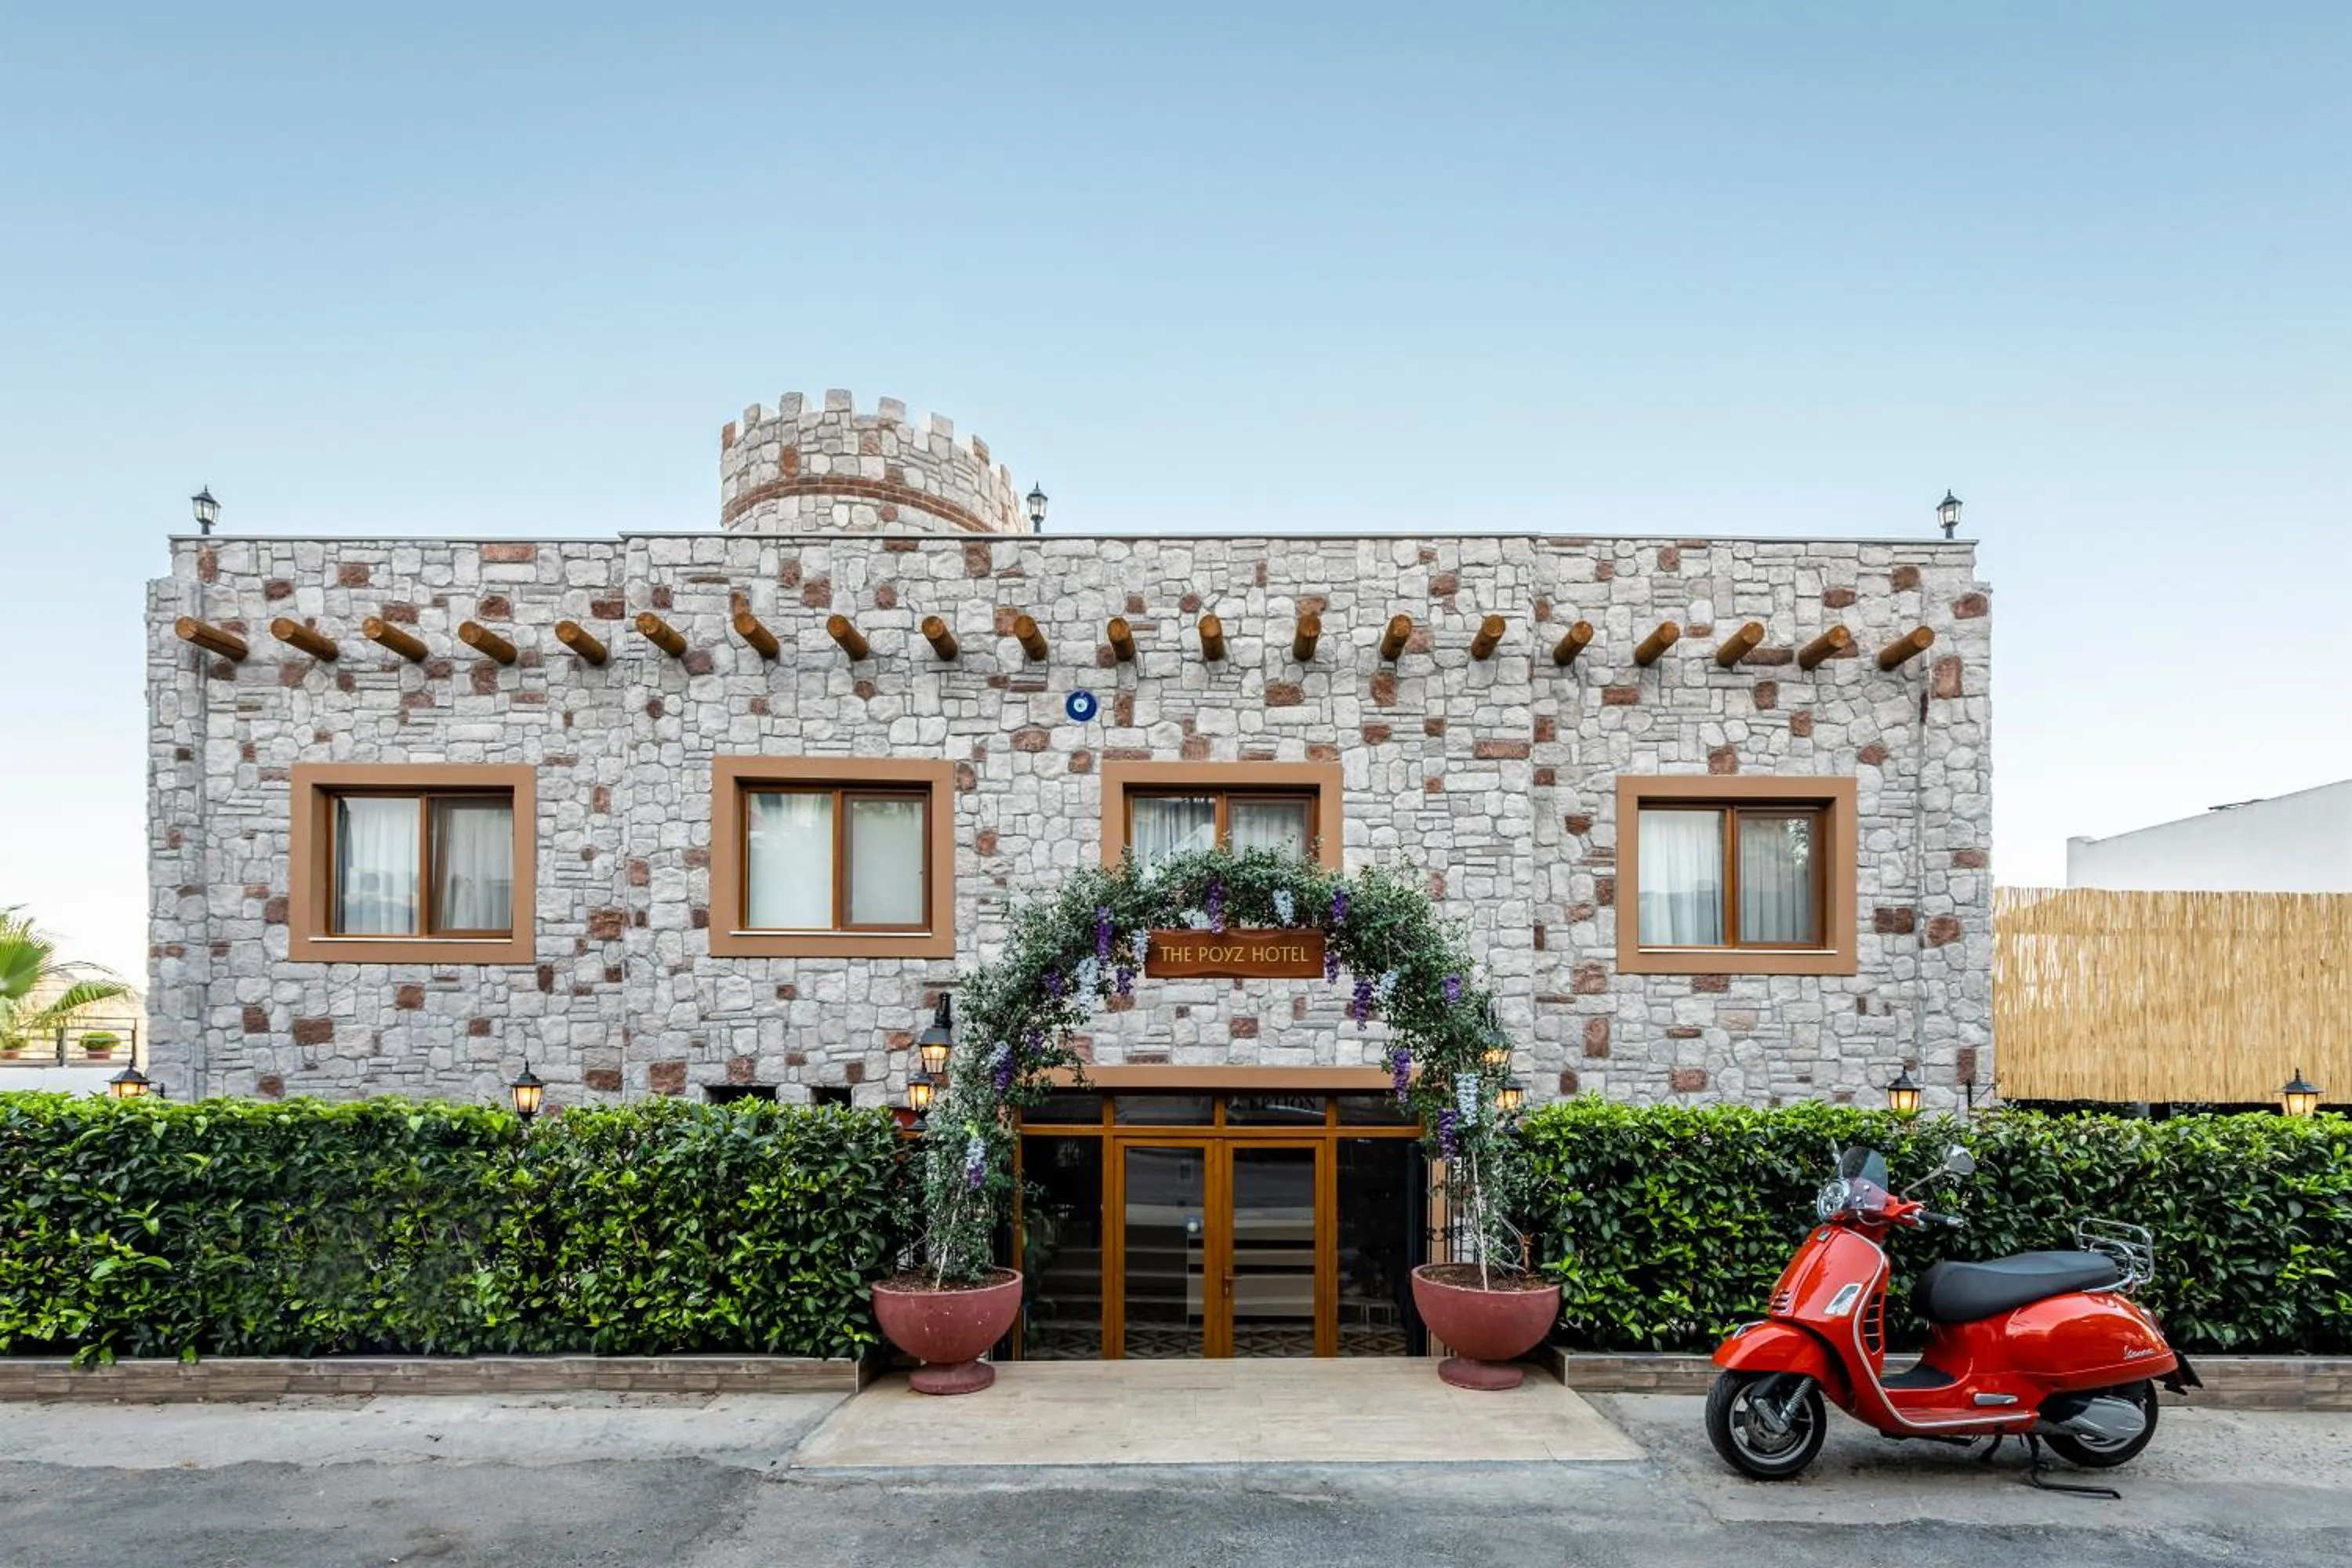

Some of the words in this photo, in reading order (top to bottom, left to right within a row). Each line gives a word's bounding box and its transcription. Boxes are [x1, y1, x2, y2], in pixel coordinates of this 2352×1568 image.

[1160, 946, 1192, 962] THE
[1199, 946, 1245, 962] POYZ
[1252, 946, 1310, 962] HOTEL
